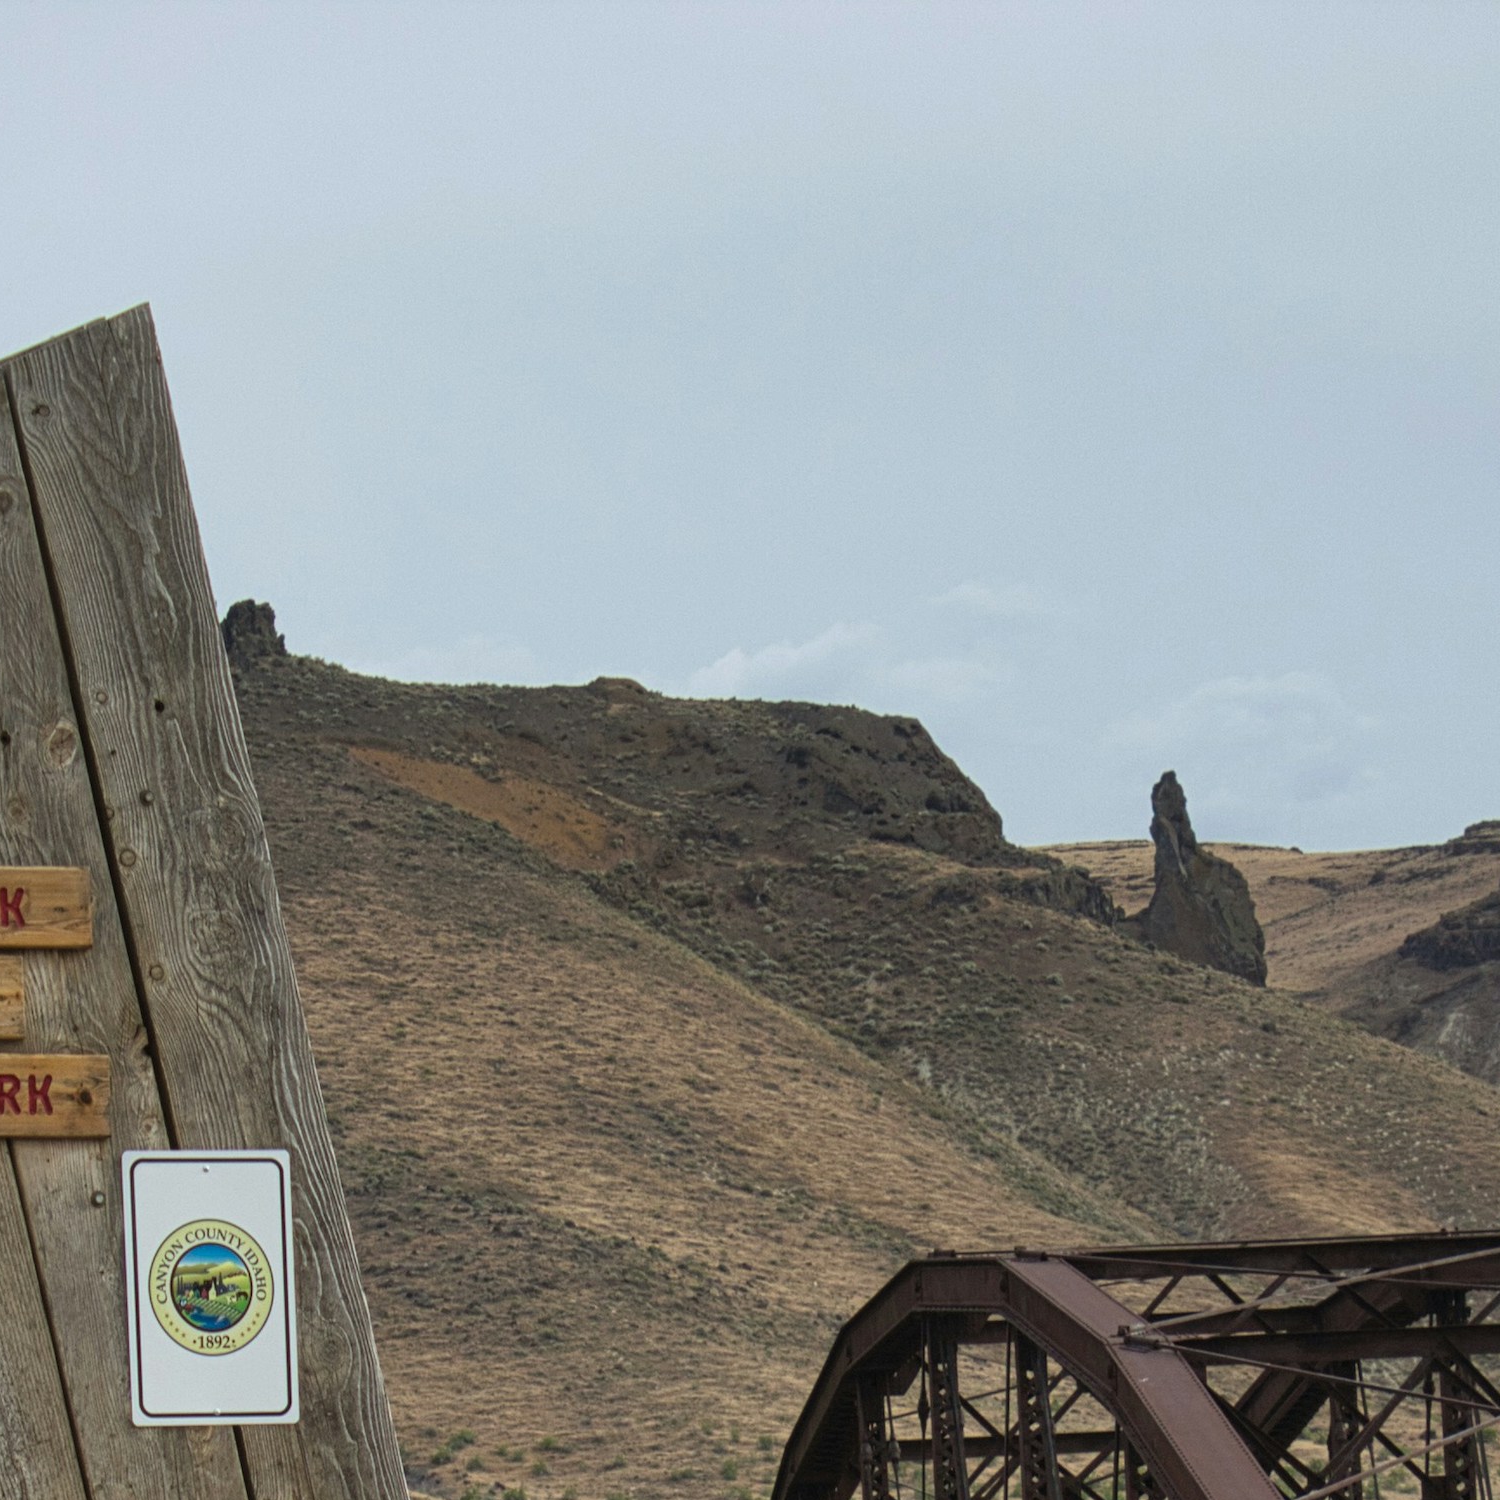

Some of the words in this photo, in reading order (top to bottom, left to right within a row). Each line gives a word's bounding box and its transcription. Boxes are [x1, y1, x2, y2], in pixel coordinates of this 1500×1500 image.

[156, 1239, 183, 1305] CANYON
[185, 1227, 247, 1250] COUNTY
[244, 1248, 267, 1302] IDAHO
[198, 1335, 231, 1349] 1892
